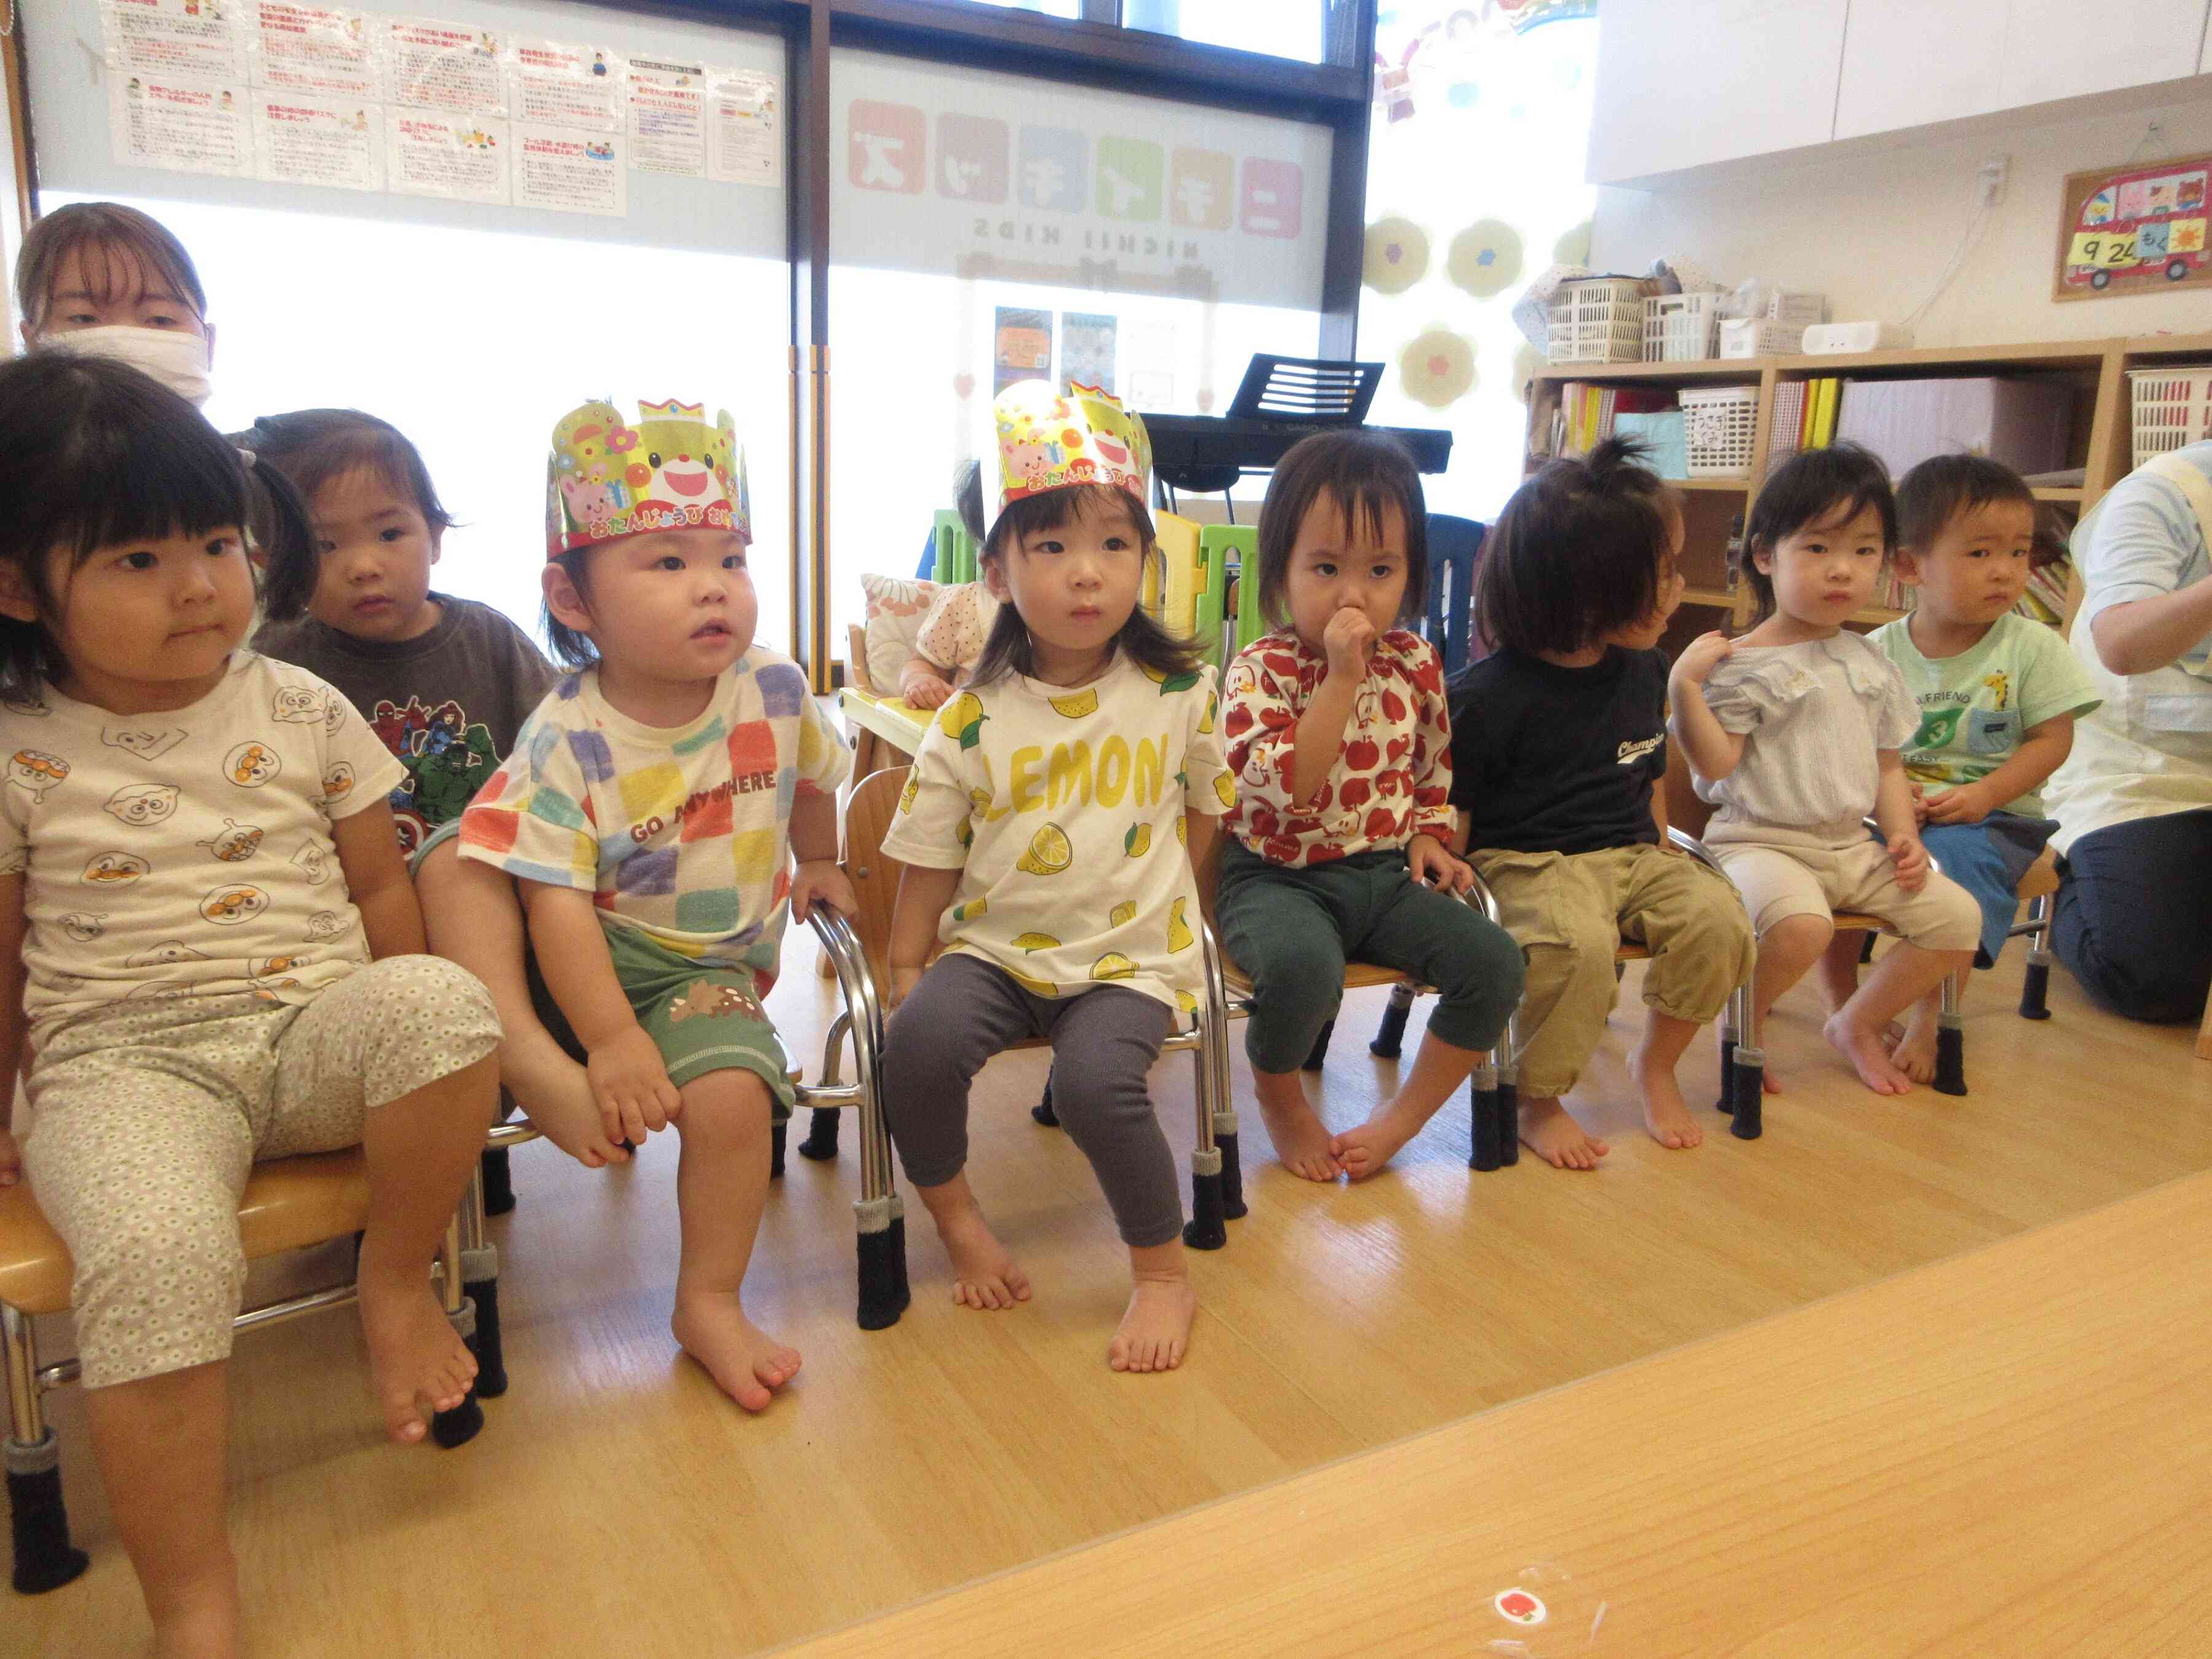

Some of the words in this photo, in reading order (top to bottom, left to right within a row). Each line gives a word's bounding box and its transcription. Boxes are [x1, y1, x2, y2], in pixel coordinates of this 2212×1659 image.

[2084, 240, 2100, 261] 9
[590, 506, 704, 538] おたんじょうび
[630, 816, 664, 843] GO
